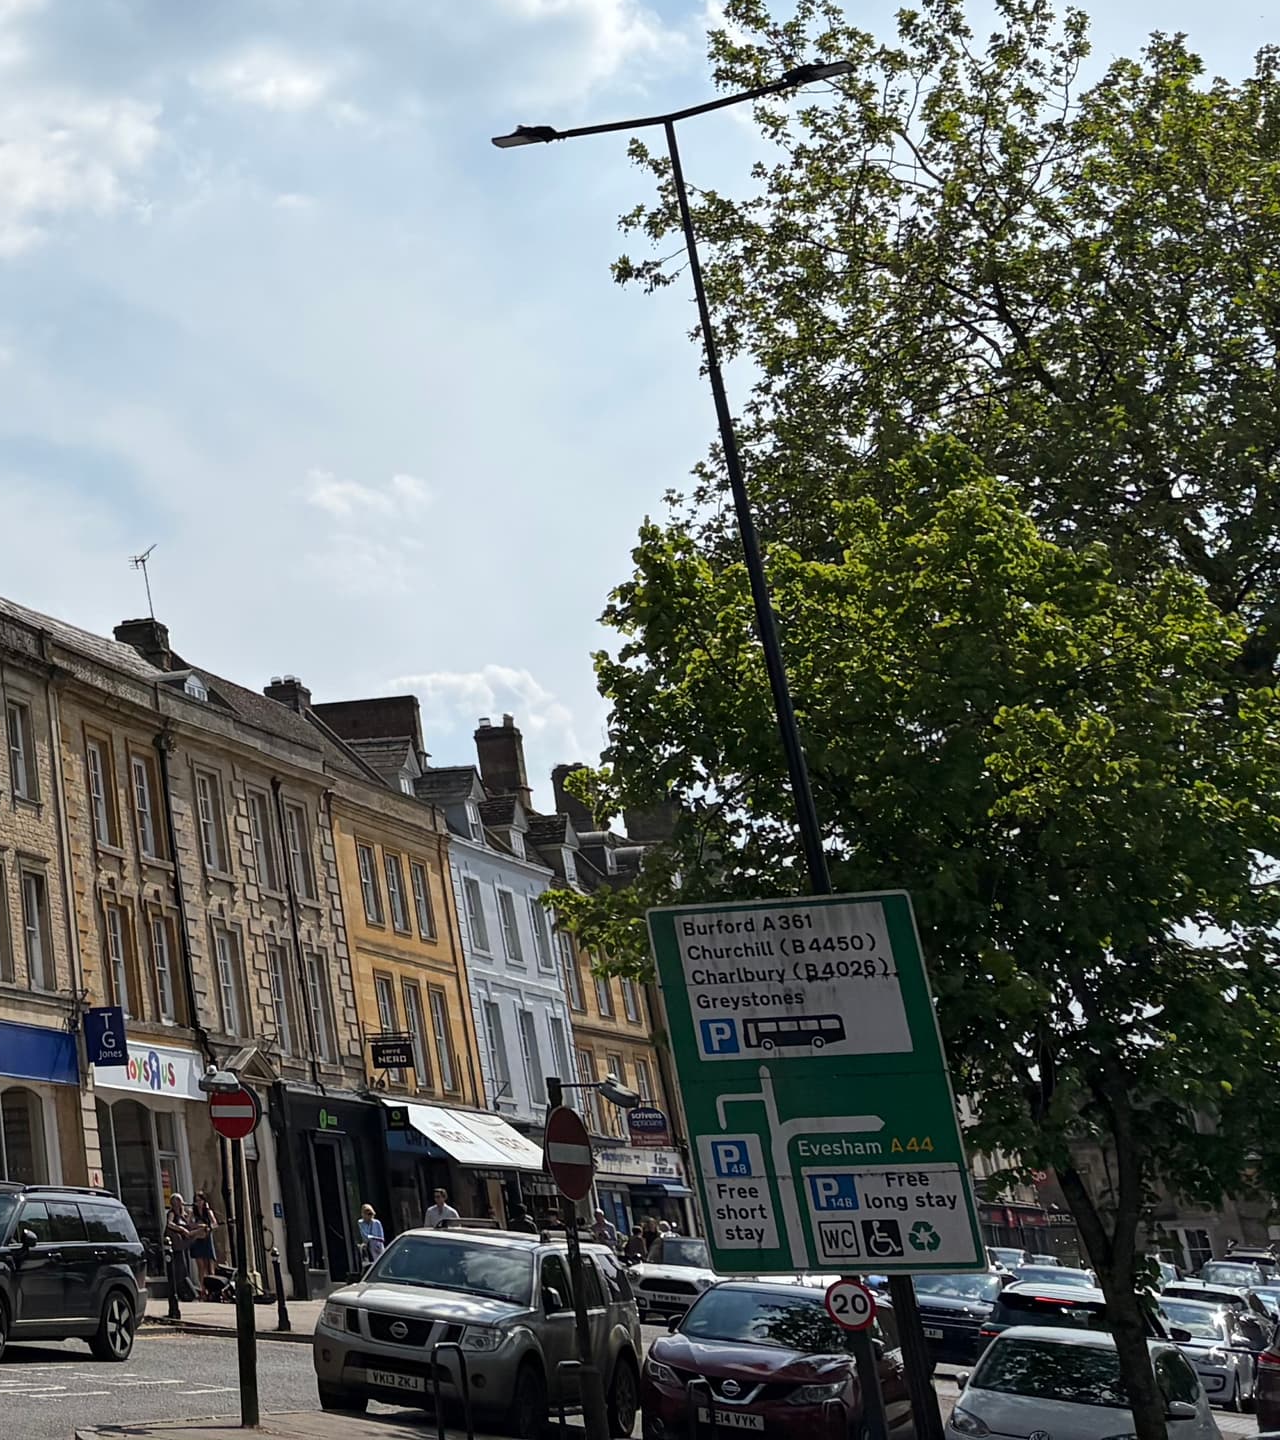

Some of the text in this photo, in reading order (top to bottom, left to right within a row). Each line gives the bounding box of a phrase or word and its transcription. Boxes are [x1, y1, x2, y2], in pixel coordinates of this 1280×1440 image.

[683, 914, 813, 936] Burford A361
[687, 941, 775, 960] Churchill
[692, 967, 785, 985] Charlbury
[697, 991, 805, 1010] Greystones
[99, 1050, 123, 1060] Jones
[631, 1111, 663, 1120] scrivens
[798, 1137, 934, 1156] Evesham A44
[885, 1172, 929, 1187] Free
[717, 1184, 759, 1199] Free
[864, 1191, 957, 1211] long stay
[716, 1204, 768, 1220] short
[726, 1225, 764, 1244] stay
[824, 1229, 854, 1249] WC
[832, 1294, 869, 1314] 20
[734, 1414, 757, 1428] VYK
